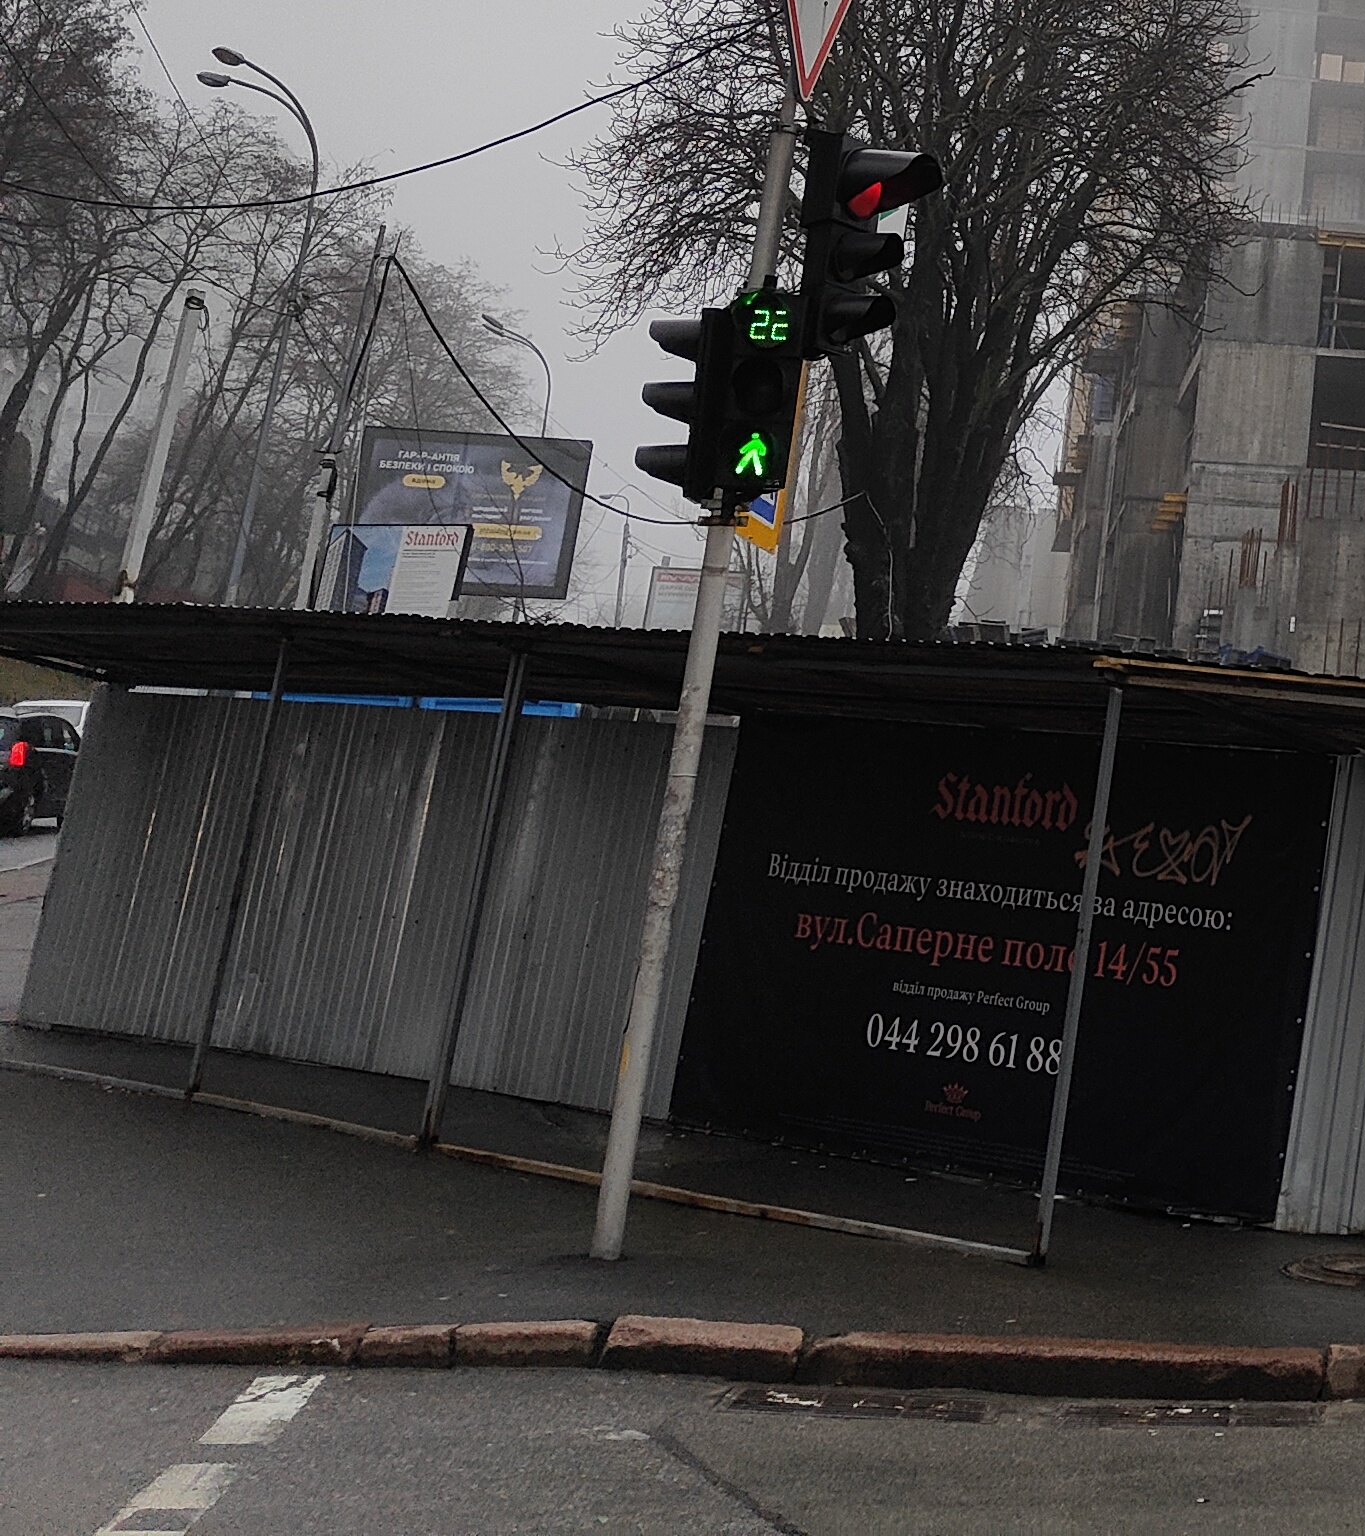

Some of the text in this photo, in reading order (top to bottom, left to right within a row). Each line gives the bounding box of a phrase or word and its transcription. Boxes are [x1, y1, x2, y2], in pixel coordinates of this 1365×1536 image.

[433, 463, 475, 474] СПОКОЮ
[405, 530, 460, 546] Stanford
[930, 772, 1079, 831] Stanford
[767, 852, 832, 886] Відділ
[834, 866, 932, 902] продажу
[935, 877, 1082, 913] знаходиться
[1121, 898, 1233, 931] адресою:
[794, 911, 995, 966] вул.Саперне
[1093, 940, 1180, 988] 14/55
[892, 979, 1051, 1015] відділ продажу Perfect Group
[866, 1012, 1064, 1076] 044 298 61 88
